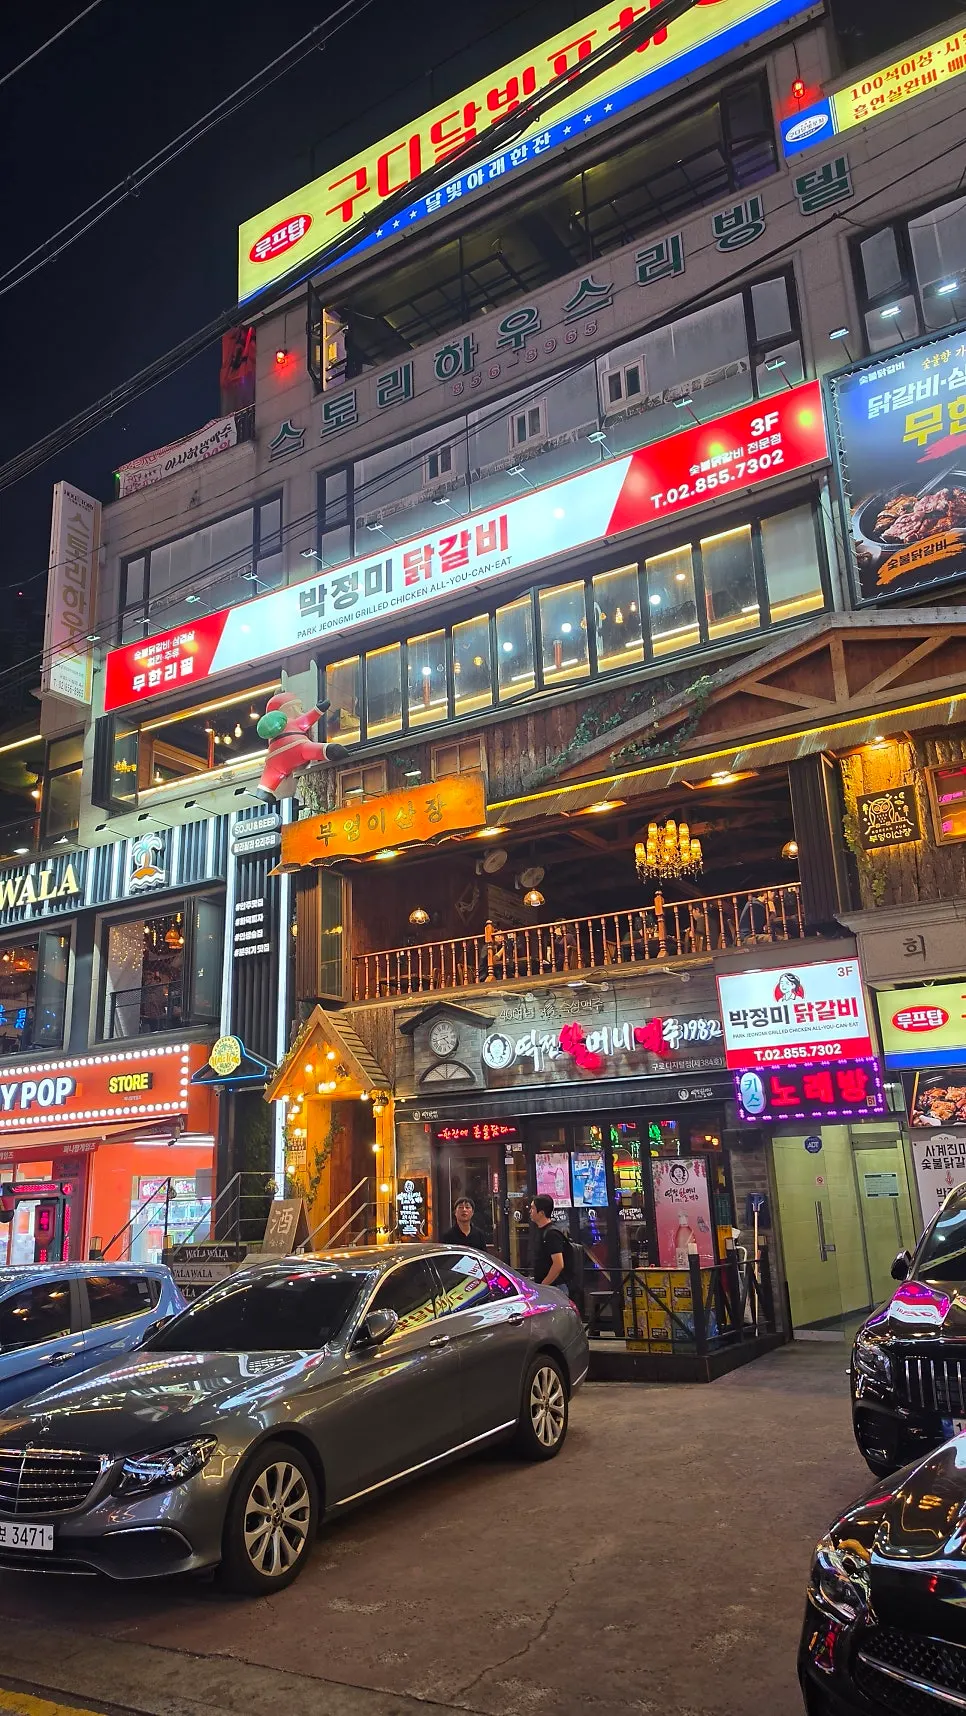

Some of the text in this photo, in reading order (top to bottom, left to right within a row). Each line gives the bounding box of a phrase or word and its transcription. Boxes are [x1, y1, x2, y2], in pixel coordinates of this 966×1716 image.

[253, 215, 307, 260] 루프탑
[451, 319, 599, 398] 856-8965
[858, 361, 905, 386] 숯불닭갈비
[750, 411, 780, 438] 3F
[747, 433, 782, 455] 전문점
[651, 449, 785, 509] T.02.855.7302
[299, 514, 509, 618] 박정미 닭갈비
[886, 539, 948, 572] 숯불닭갈비
[297, 556, 513, 639] PARK JEONGMI GRILLED CHICKEN ALL-YOU-CAN-EAT
[132, 656, 194, 692] 무한리필
[315, 793, 448, 848] 부엉이산장
[869, 828, 912, 843] 부엉이산장
[837, 965, 854, 978] 3F
[728, 997, 859, 1029] 박정미 닭갈비
[896, 1010, 944, 1029] 루프탑
[753, 1043, 842, 1062] T.02.855.7302
[109, 1073, 150, 1094] STORE
[743, 1067, 869, 1109] 키스 노래방
[807, 1141, 820, 1149] ADT
[269, 1207, 294, 1234] 酒
[12, 1526, 45, 1547] 3471
